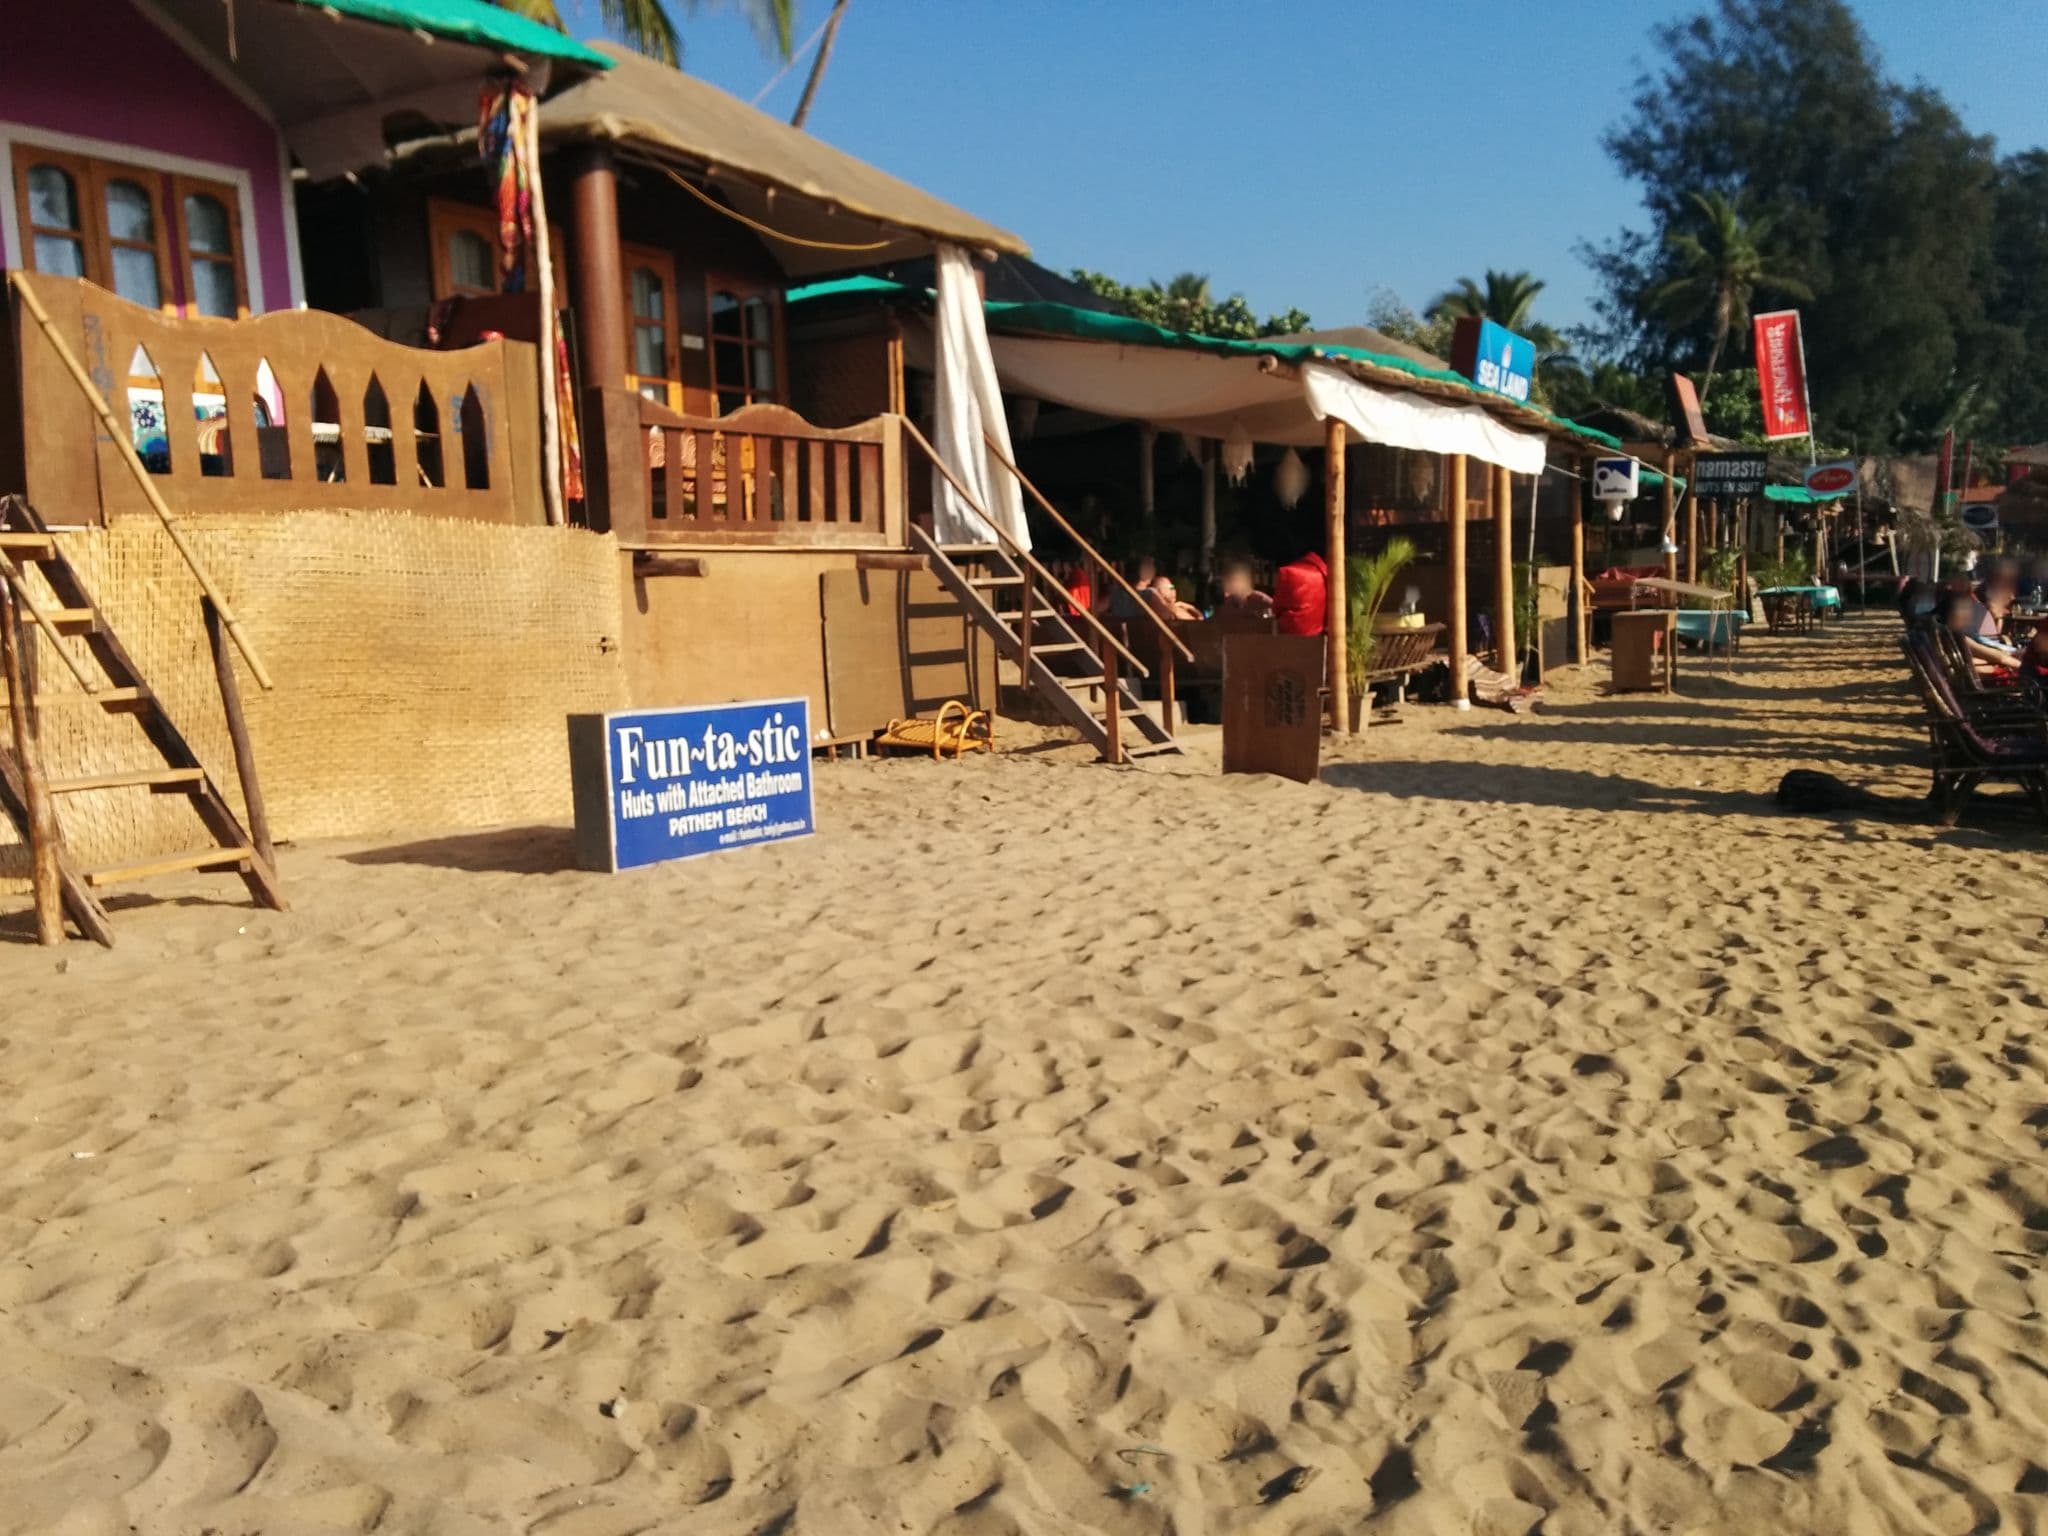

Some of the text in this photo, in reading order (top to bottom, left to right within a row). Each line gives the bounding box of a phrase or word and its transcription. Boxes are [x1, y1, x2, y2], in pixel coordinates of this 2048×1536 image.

[1478, 359, 1528, 401] SEA LAND
[1722, 481, 1735, 492] EN
[621, 770, 802, 820] Huts with Attached Bathroom
[669, 811, 724, 837] PATNEM
[726, 803, 768, 827] BEACH
